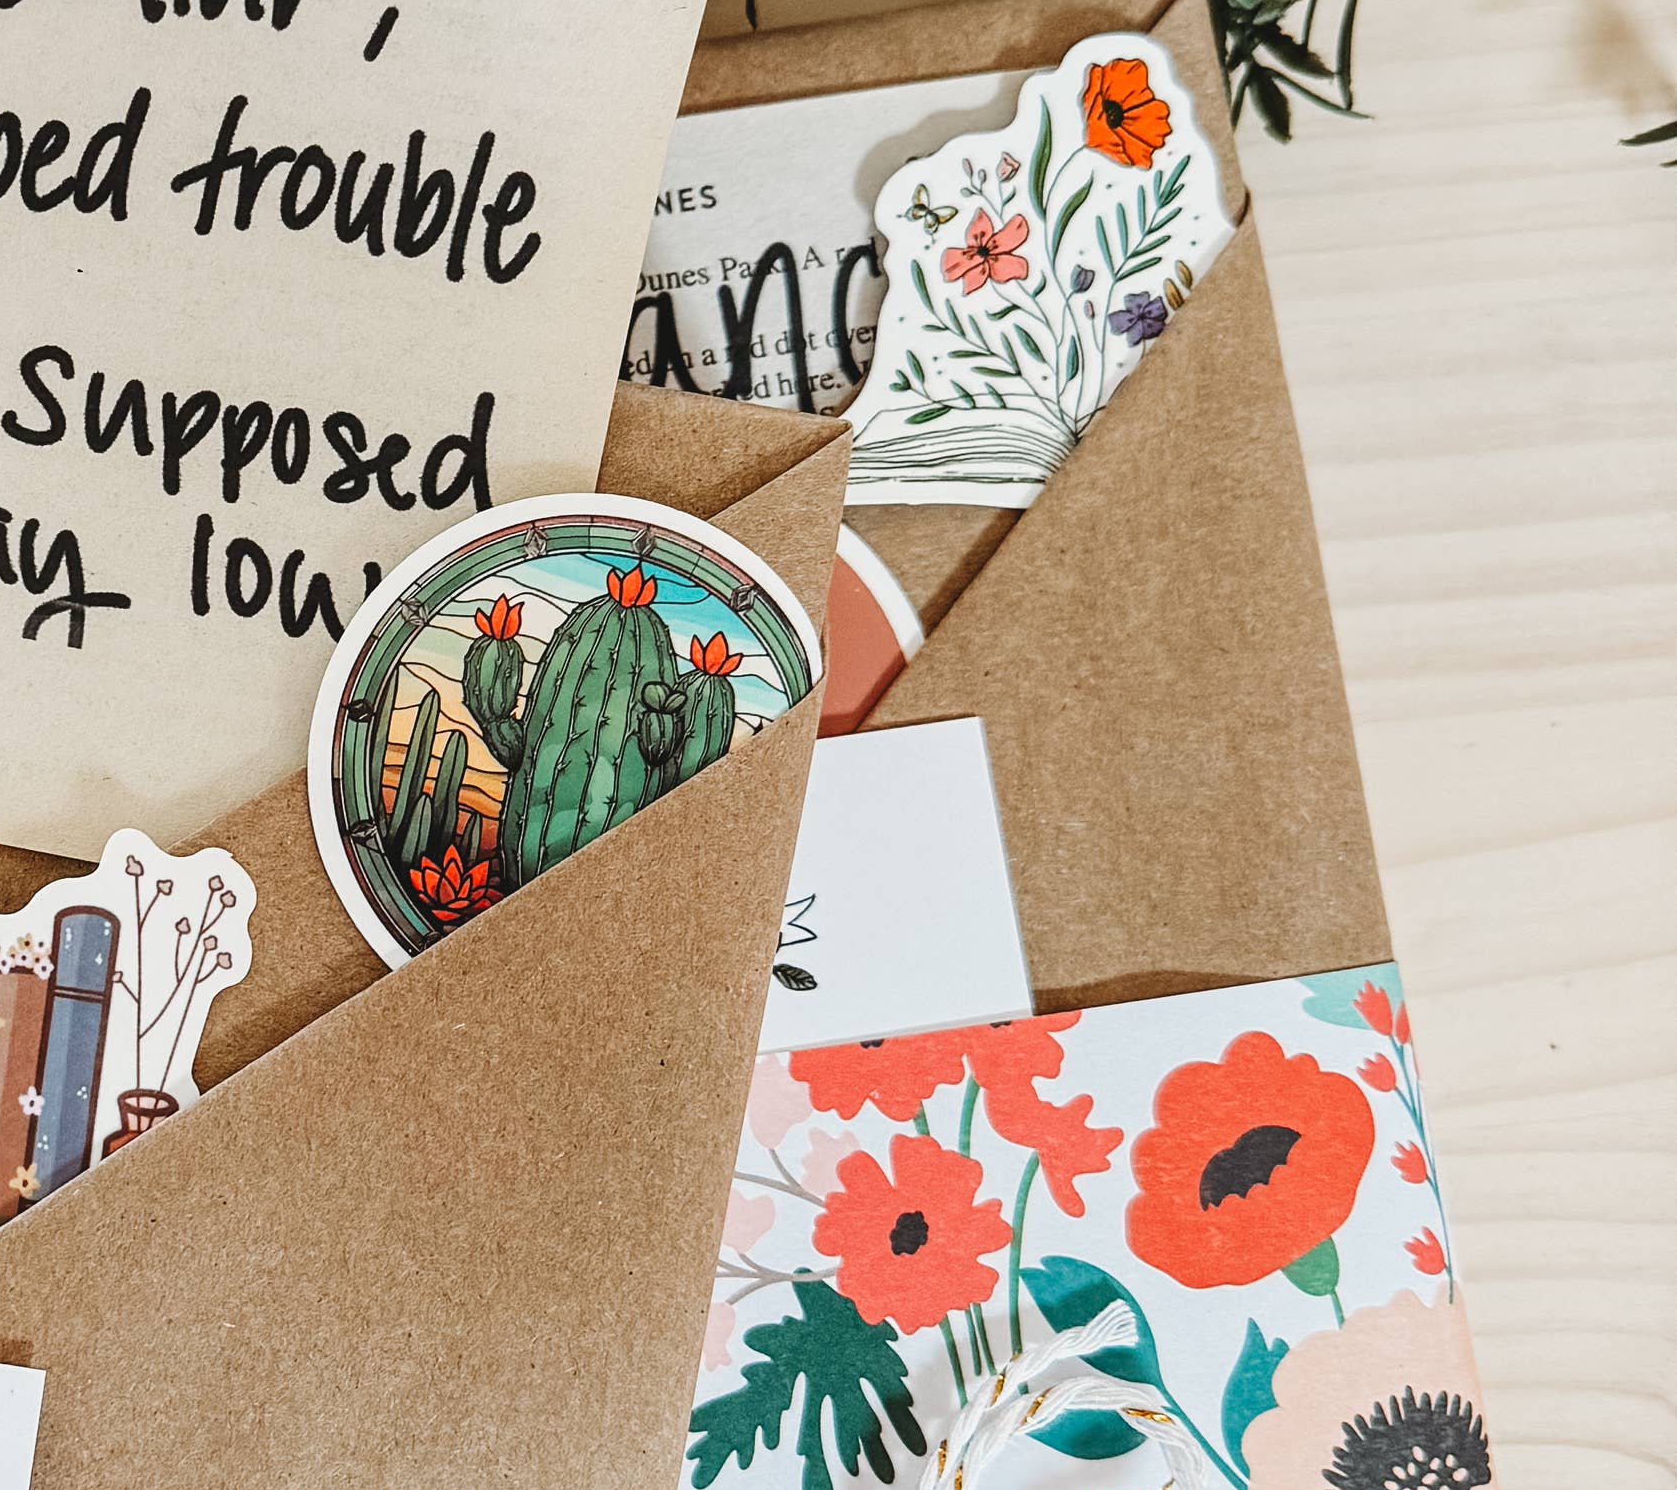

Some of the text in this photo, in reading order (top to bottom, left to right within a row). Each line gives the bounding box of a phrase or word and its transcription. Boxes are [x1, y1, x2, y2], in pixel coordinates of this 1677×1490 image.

[170, 94, 542, 284] trouble
[802, 245, 825, 271] A
[777, 369, 843, 398] hre.
[189, 512, 380, 642] low
